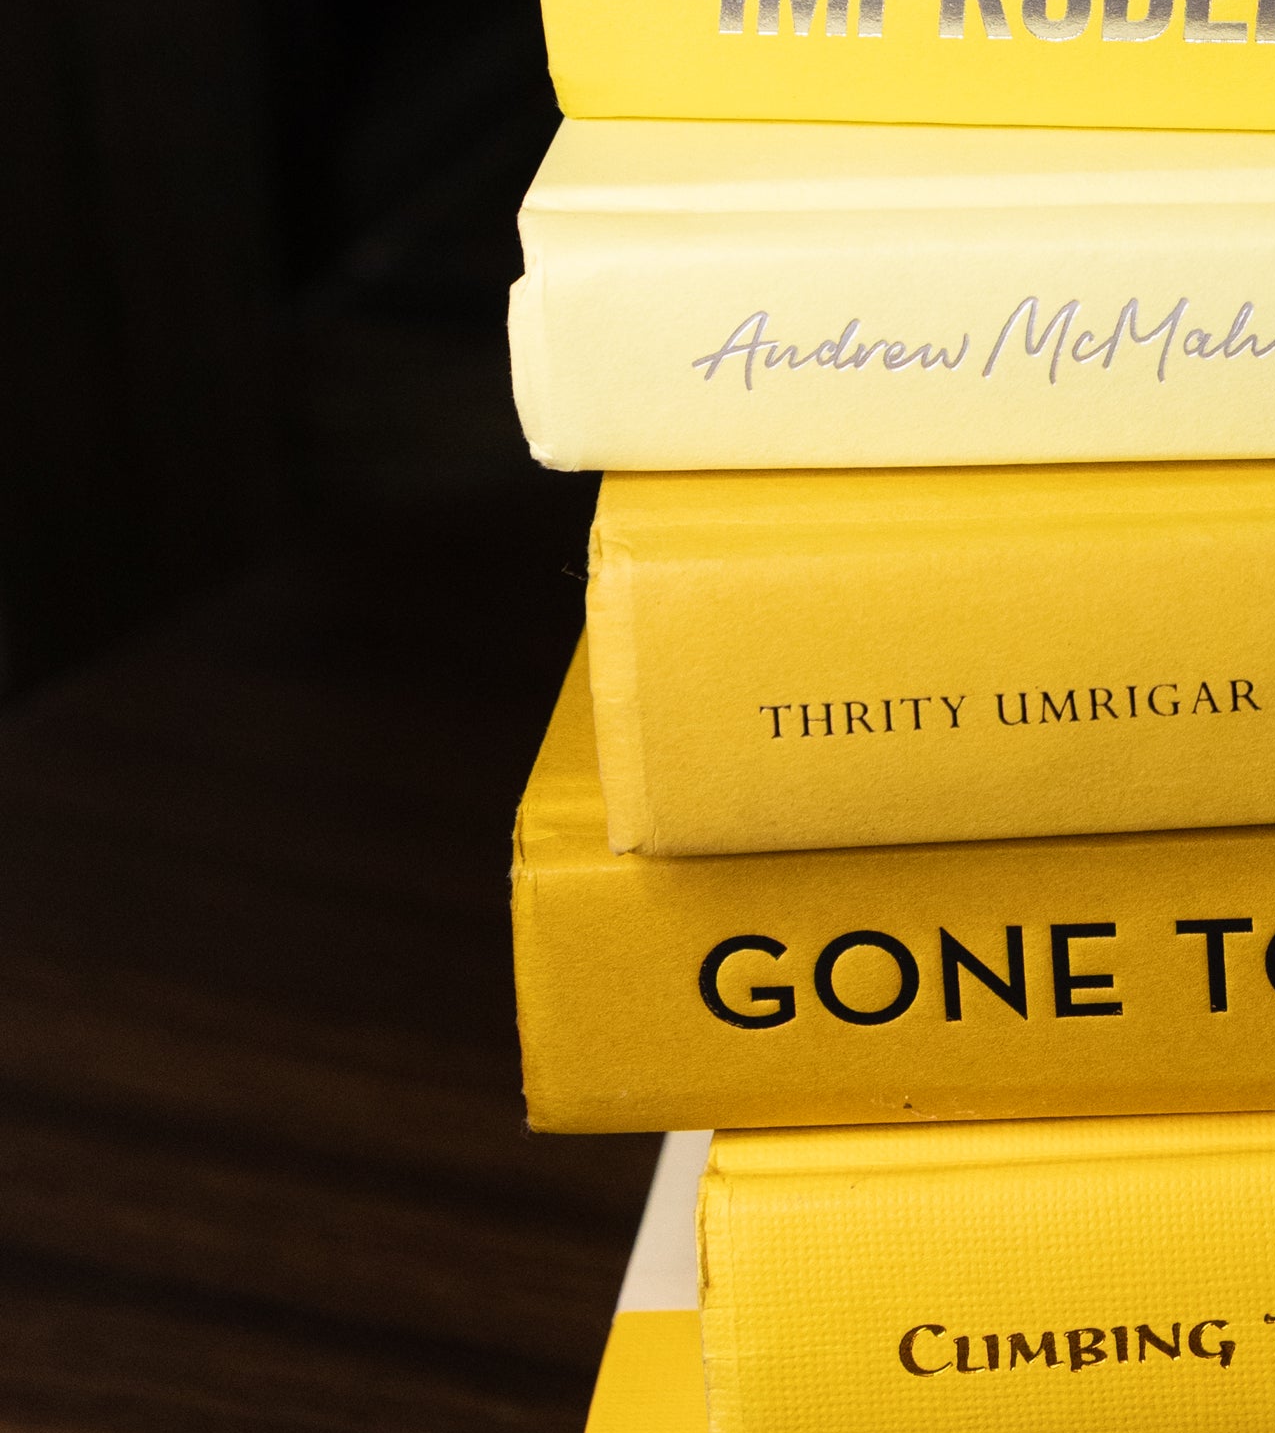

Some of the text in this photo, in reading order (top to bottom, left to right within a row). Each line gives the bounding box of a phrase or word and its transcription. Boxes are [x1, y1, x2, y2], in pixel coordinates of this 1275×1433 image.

[692, 310, 970, 392] Andrew
[759, 678, 1262, 740] THRITY UMRIGAR
[698, 921, 1125, 1030] GONE
